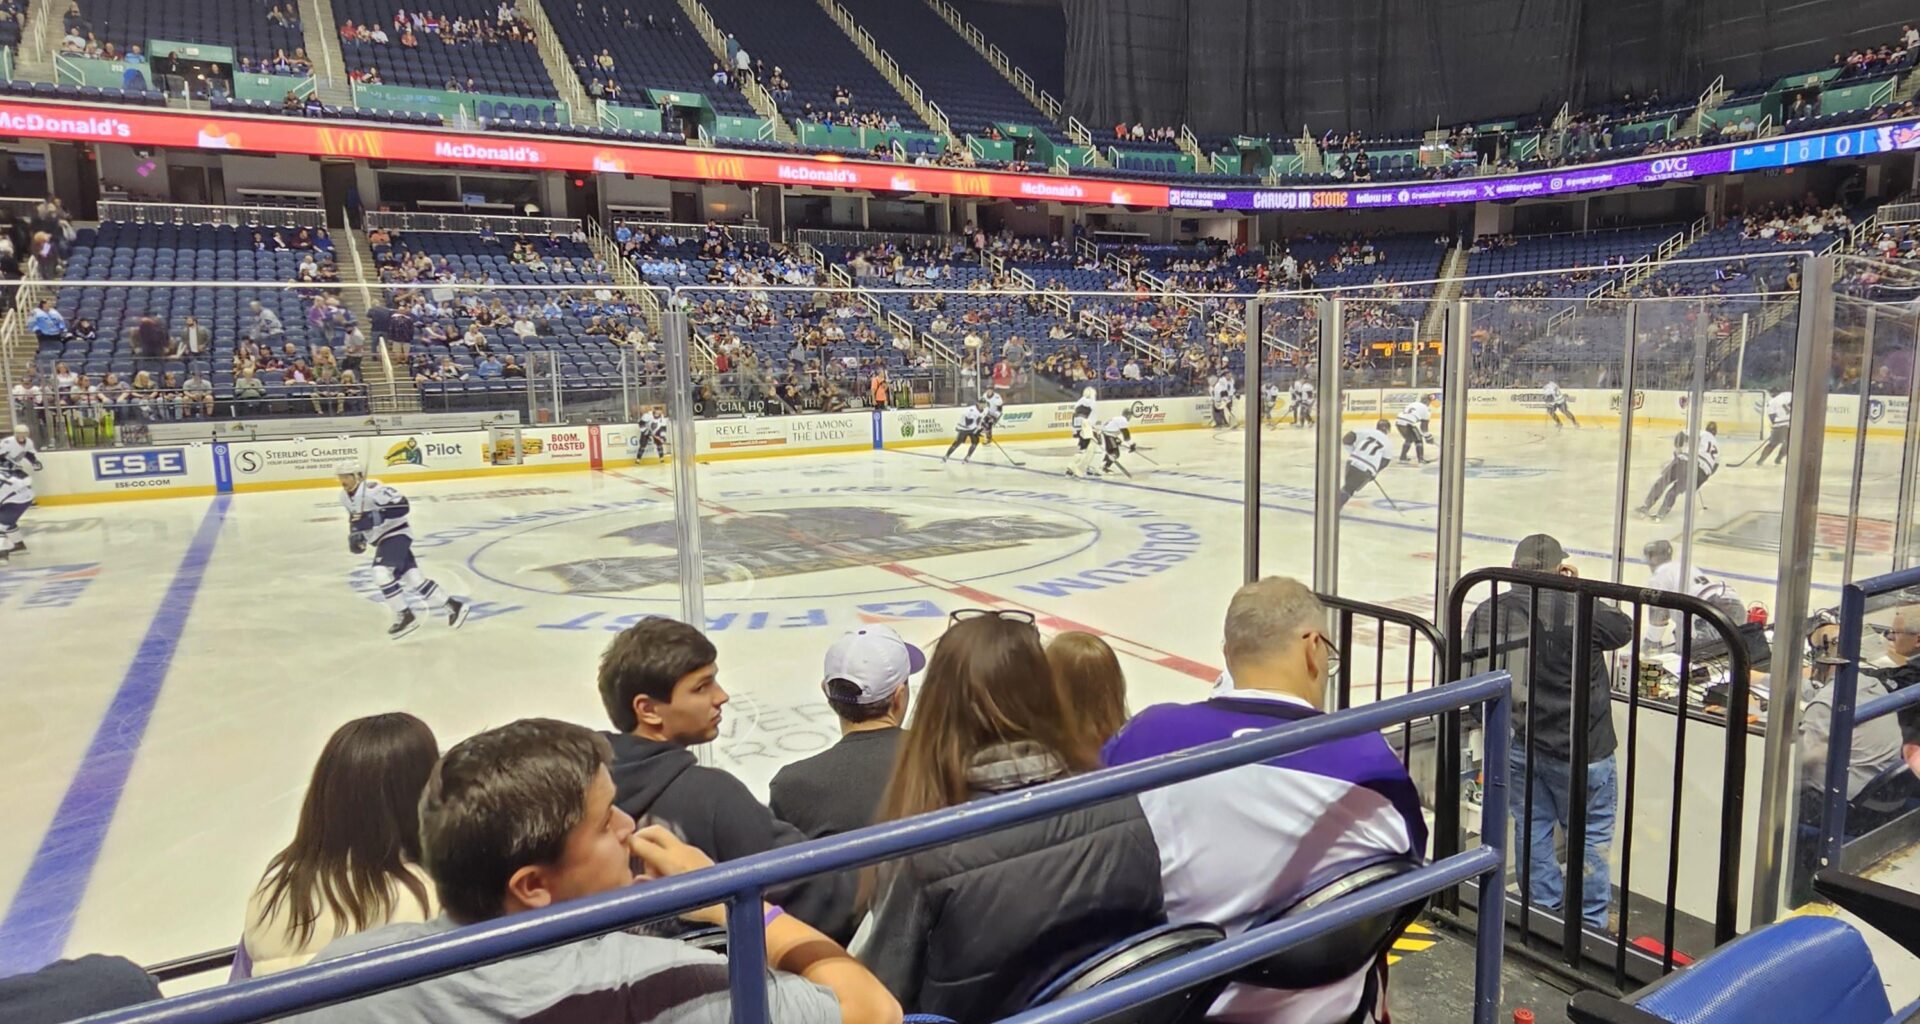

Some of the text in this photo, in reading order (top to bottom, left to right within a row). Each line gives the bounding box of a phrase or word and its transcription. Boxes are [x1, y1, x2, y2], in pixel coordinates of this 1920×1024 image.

[0, 110, 131, 137] McDonald's
[434, 141, 540, 163] McDonald's
[1800, 147, 1809, 160] 0
[1835, 136, 1851, 155] 0
[778, 165, 857, 183] McDonald's
[1651, 157, 1688, 174] OVG
[1021, 182, 1084, 199] McDonald's
[1356, 193, 1393, 204] follow us
[1131, 401, 1160, 419] Casey's
[715, 425, 749, 436] REVEL
[792, 421, 813, 431] LIVE
[816, 419, 853, 430] AMONG
[551, 433, 580, 443] BOOM.
[793, 432, 811, 442] THE
[814, 430, 845, 441] LIVELY
[425, 443, 462, 456] Pilot
[546, 442, 585, 452] TOASTED
[1360, 436, 1384, 456] 77
[1014, 521, 1201, 598] COLISEUM
